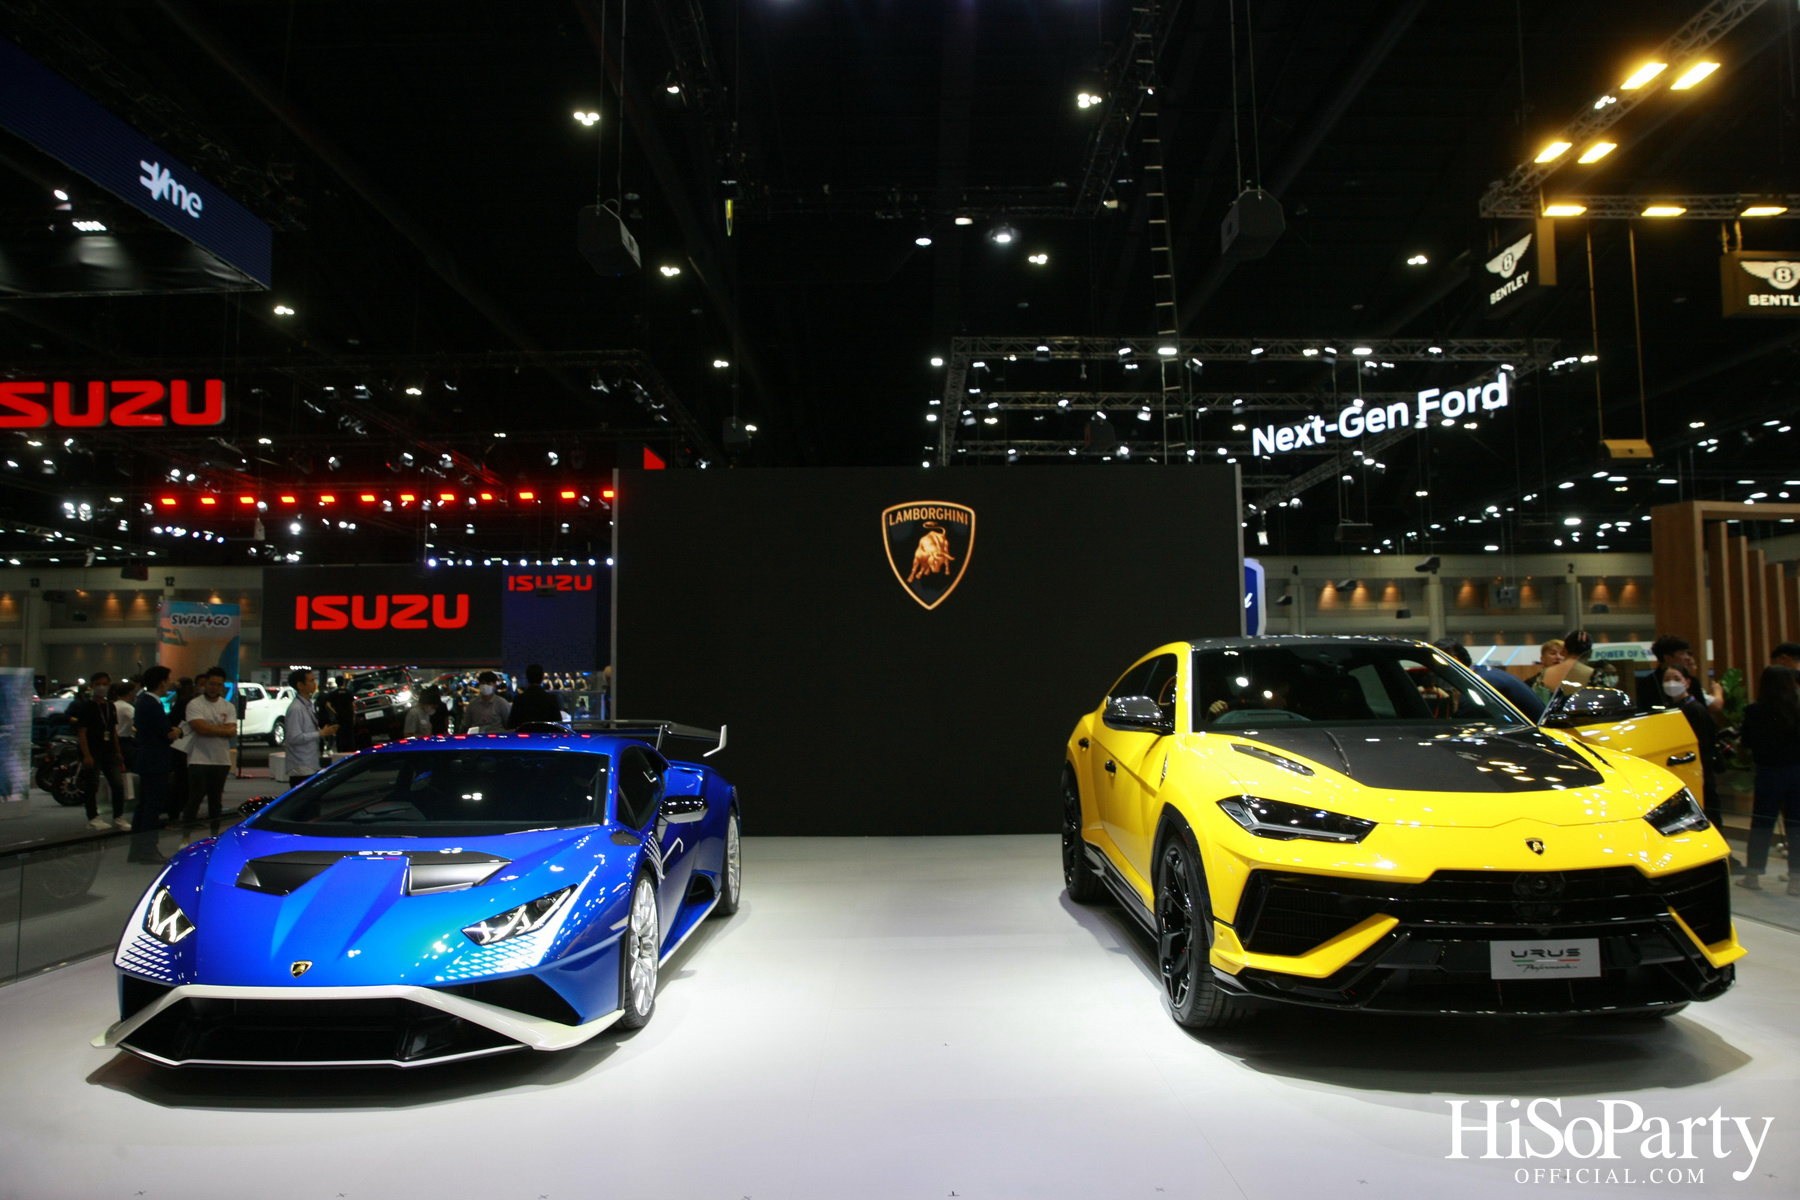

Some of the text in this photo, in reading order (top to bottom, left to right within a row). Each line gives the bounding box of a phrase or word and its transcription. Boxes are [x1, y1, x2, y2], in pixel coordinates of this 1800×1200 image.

[1489, 270, 1530, 305] BENTLEY
[1748, 294, 1800, 307] BENTL
[1252, 372, 1508, 456] Next-Gen Ford
[889, 507, 969, 526] LAMBORGHINI
[164, 576, 176, 587] 12
[295, 594, 470, 630] ISUZU
[171, 614, 230, 626] SWAP GO
[1595, 650, 1625, 658] POWER
[1627, 649, 1638, 657] OF
[1511, 948, 1580, 958] URUS
